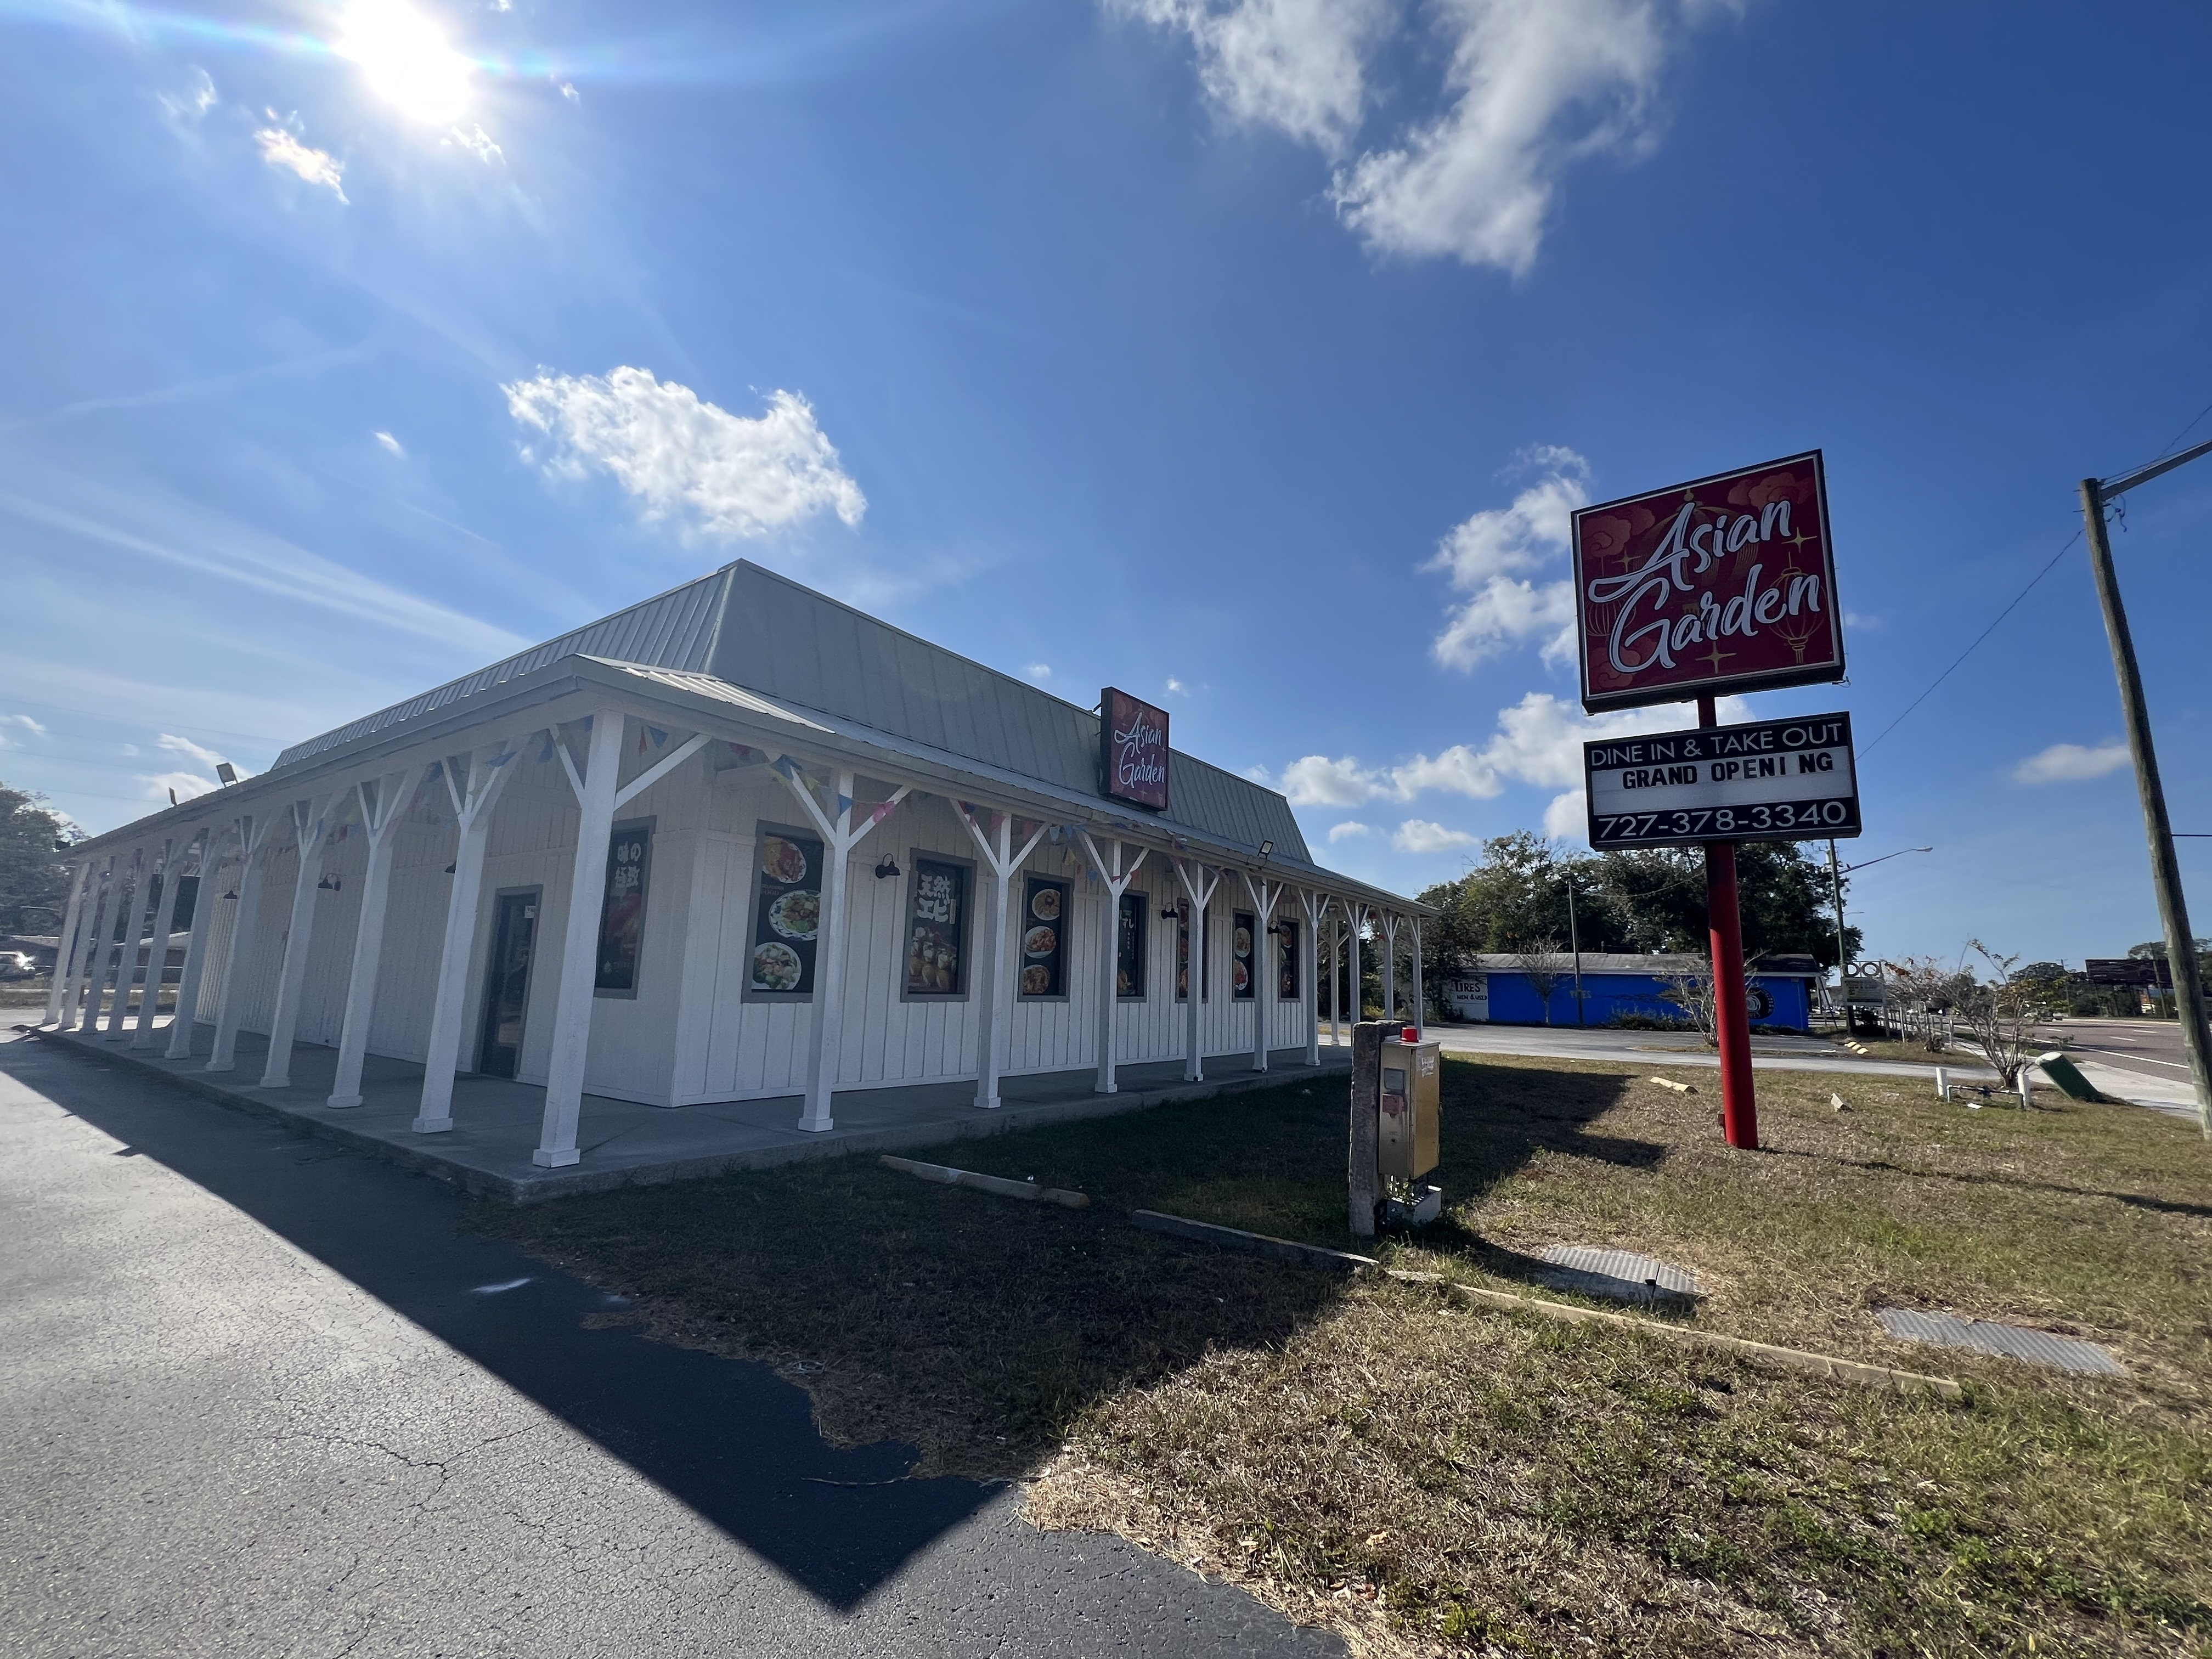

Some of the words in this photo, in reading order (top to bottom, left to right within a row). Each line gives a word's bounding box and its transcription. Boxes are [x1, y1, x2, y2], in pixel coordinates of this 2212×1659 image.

[1588, 500, 1791, 602] Asian
[1609, 564, 1820, 673] Garden
[1114, 712, 1162, 754] Asian
[1591, 745, 1643, 766] DINE
[1651, 741, 1675, 759] IN
[1684, 738, 1702, 757] &
[1710, 731, 1774, 754] TAKE
[1782, 723, 1842, 747] OUT
[1119, 742, 1165, 788] Garden
[1622, 764, 1697, 789] GRAND
[1598, 802, 1847, 838] 727-378-3340
[1453, 979, 1481, 992] TIRES
